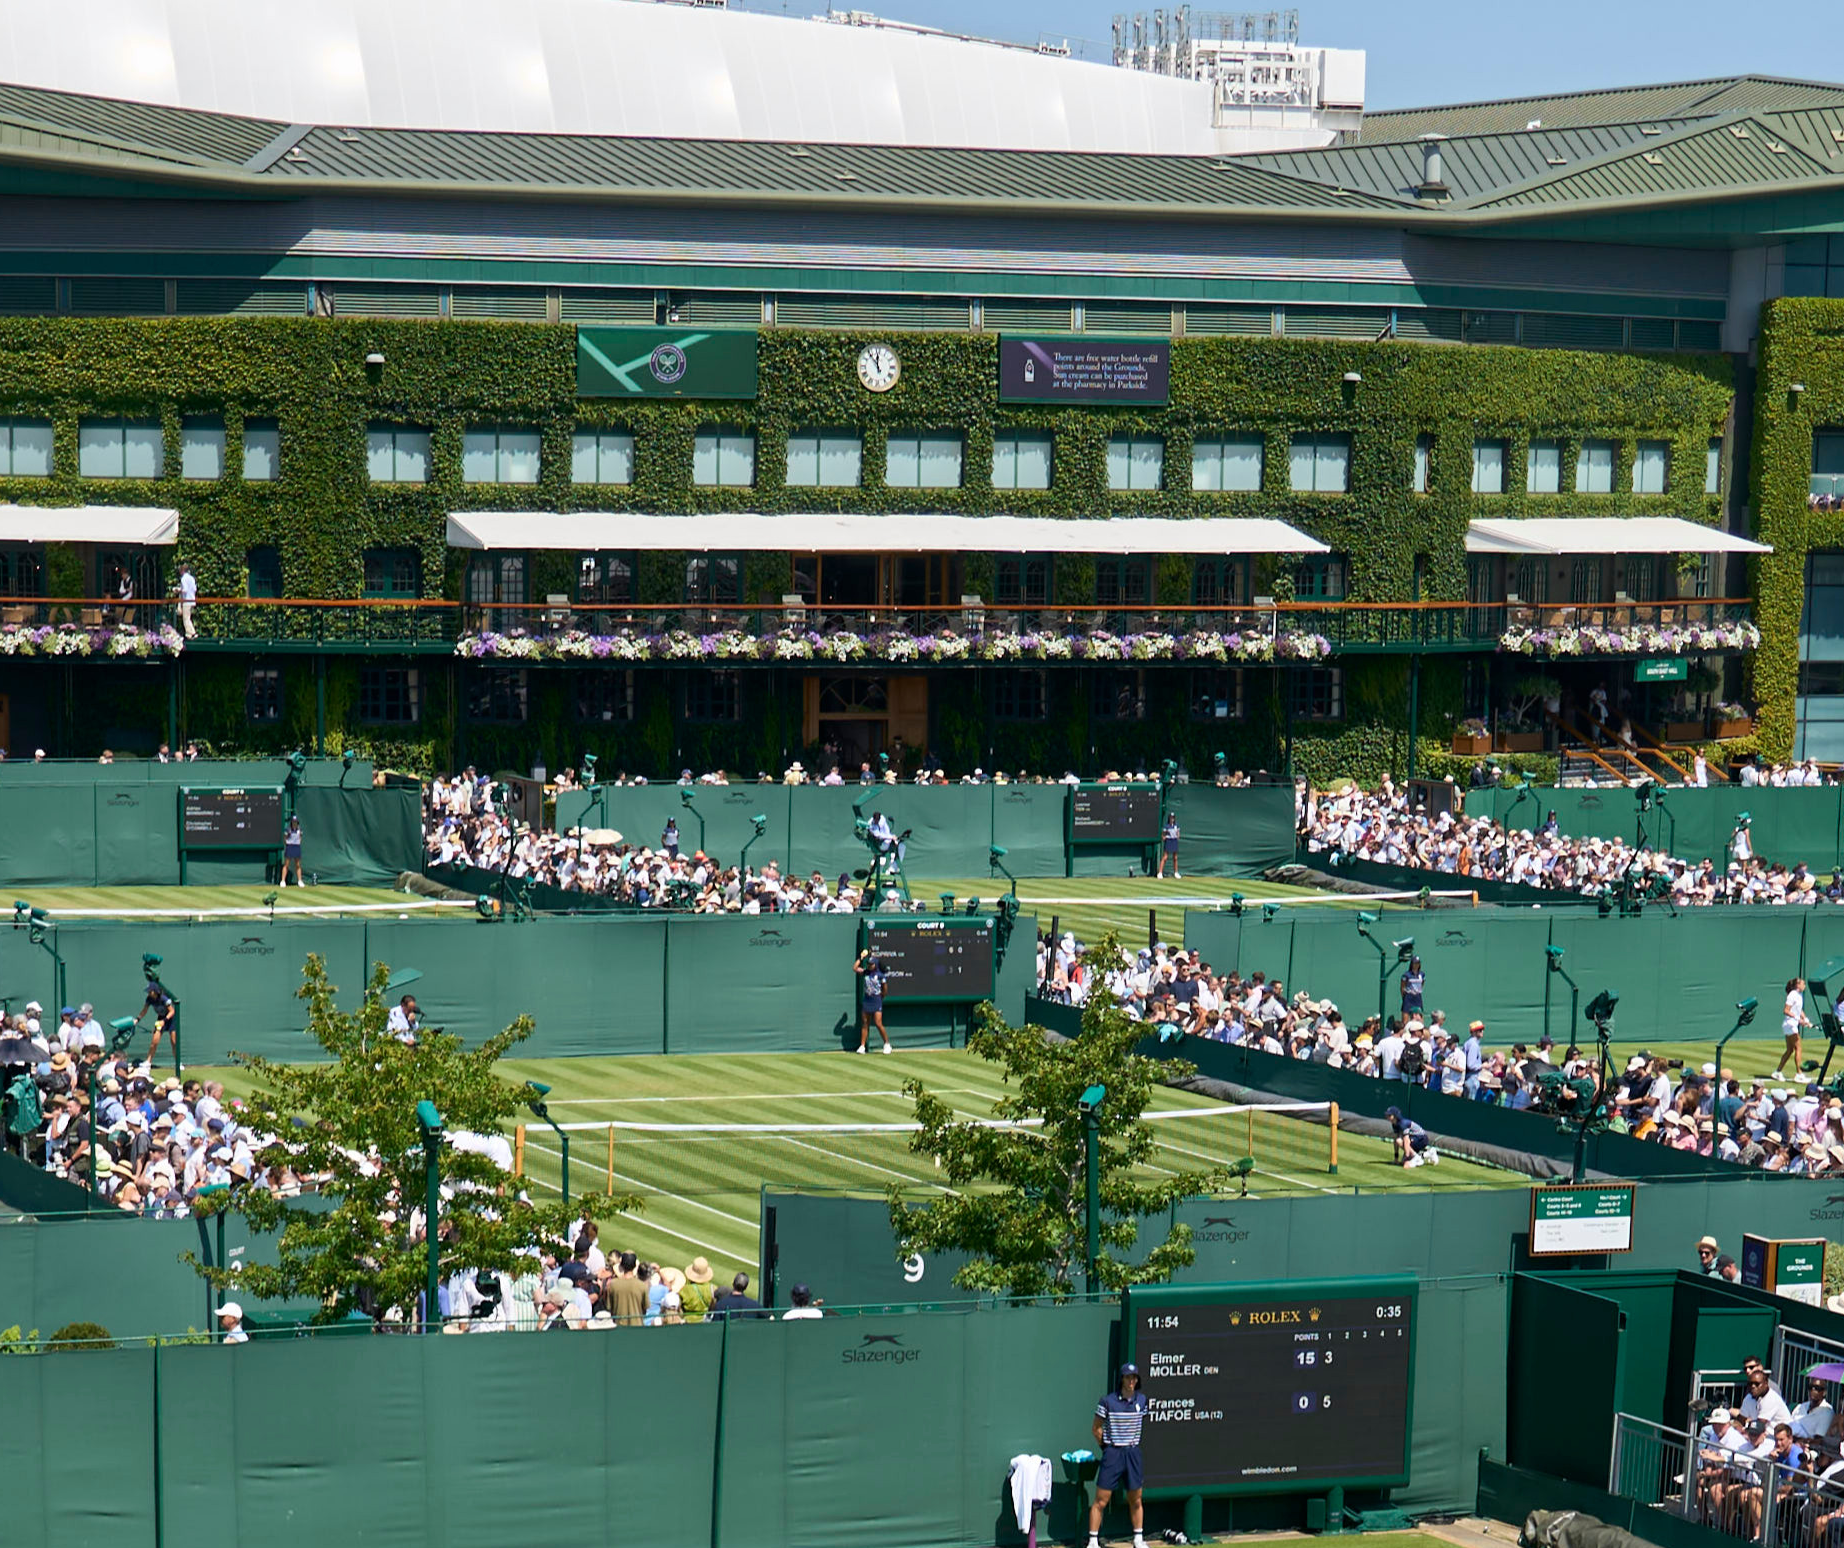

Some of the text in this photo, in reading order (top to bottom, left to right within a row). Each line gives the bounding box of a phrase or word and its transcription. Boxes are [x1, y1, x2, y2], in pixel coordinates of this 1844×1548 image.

[1054, 352, 1073, 361] There
[1086, 353, 1099, 362] free
[1100, 354, 1119, 362] water
[1120, 353, 1141, 363] bottle
[1142, 354, 1158, 363] refill
[1053, 363, 1075, 373] points
[1076, 362, 1100, 371] around
[1101, 363, 1113, 371] the
[1052, 371, 1067, 379] Sun
[1103, 371, 1112, 379] be
[1113, 371, 1148, 382] purchased
[1052, 380, 1060, 388] at
[1061, 380, 1073, 388] the
[1073, 380, 1106, 391] pharmacy
[1108, 381, 1115, 389] in
[748, 936, 794, 948] Slazenger
[229, 944, 276, 957] Slazenger
[904, 1252, 924, 1283] 9
[1249, 1310, 1301, 1325] ROLEX
[1376, 1305, 1402, 1319] 0:35
[1147, 1315, 1179, 1329] 11:54
[1294, 1332, 1320, 1342] POINTS
[1327, 1332, 1332, 1341] 1
[1345, 1331, 1350, 1340] 2
[1362, 1330, 1368, 1339] 3
[1380, 1329, 1385, 1338] 4
[842, 1348, 923, 1366] Slazenger
[1150, 1352, 1185, 1364] Elmer
[1297, 1350, 1333, 1365] 15 3
[1203, 1366, 1219, 1375] DEN
[1148, 1398, 1195, 1410] Frances
[1298, 1395, 1331, 1409] 0 5
[1148, 1409, 1224, 1422] TIAFOE USA (12)
[1241, 1465, 1298, 1475] wimbledon.com
